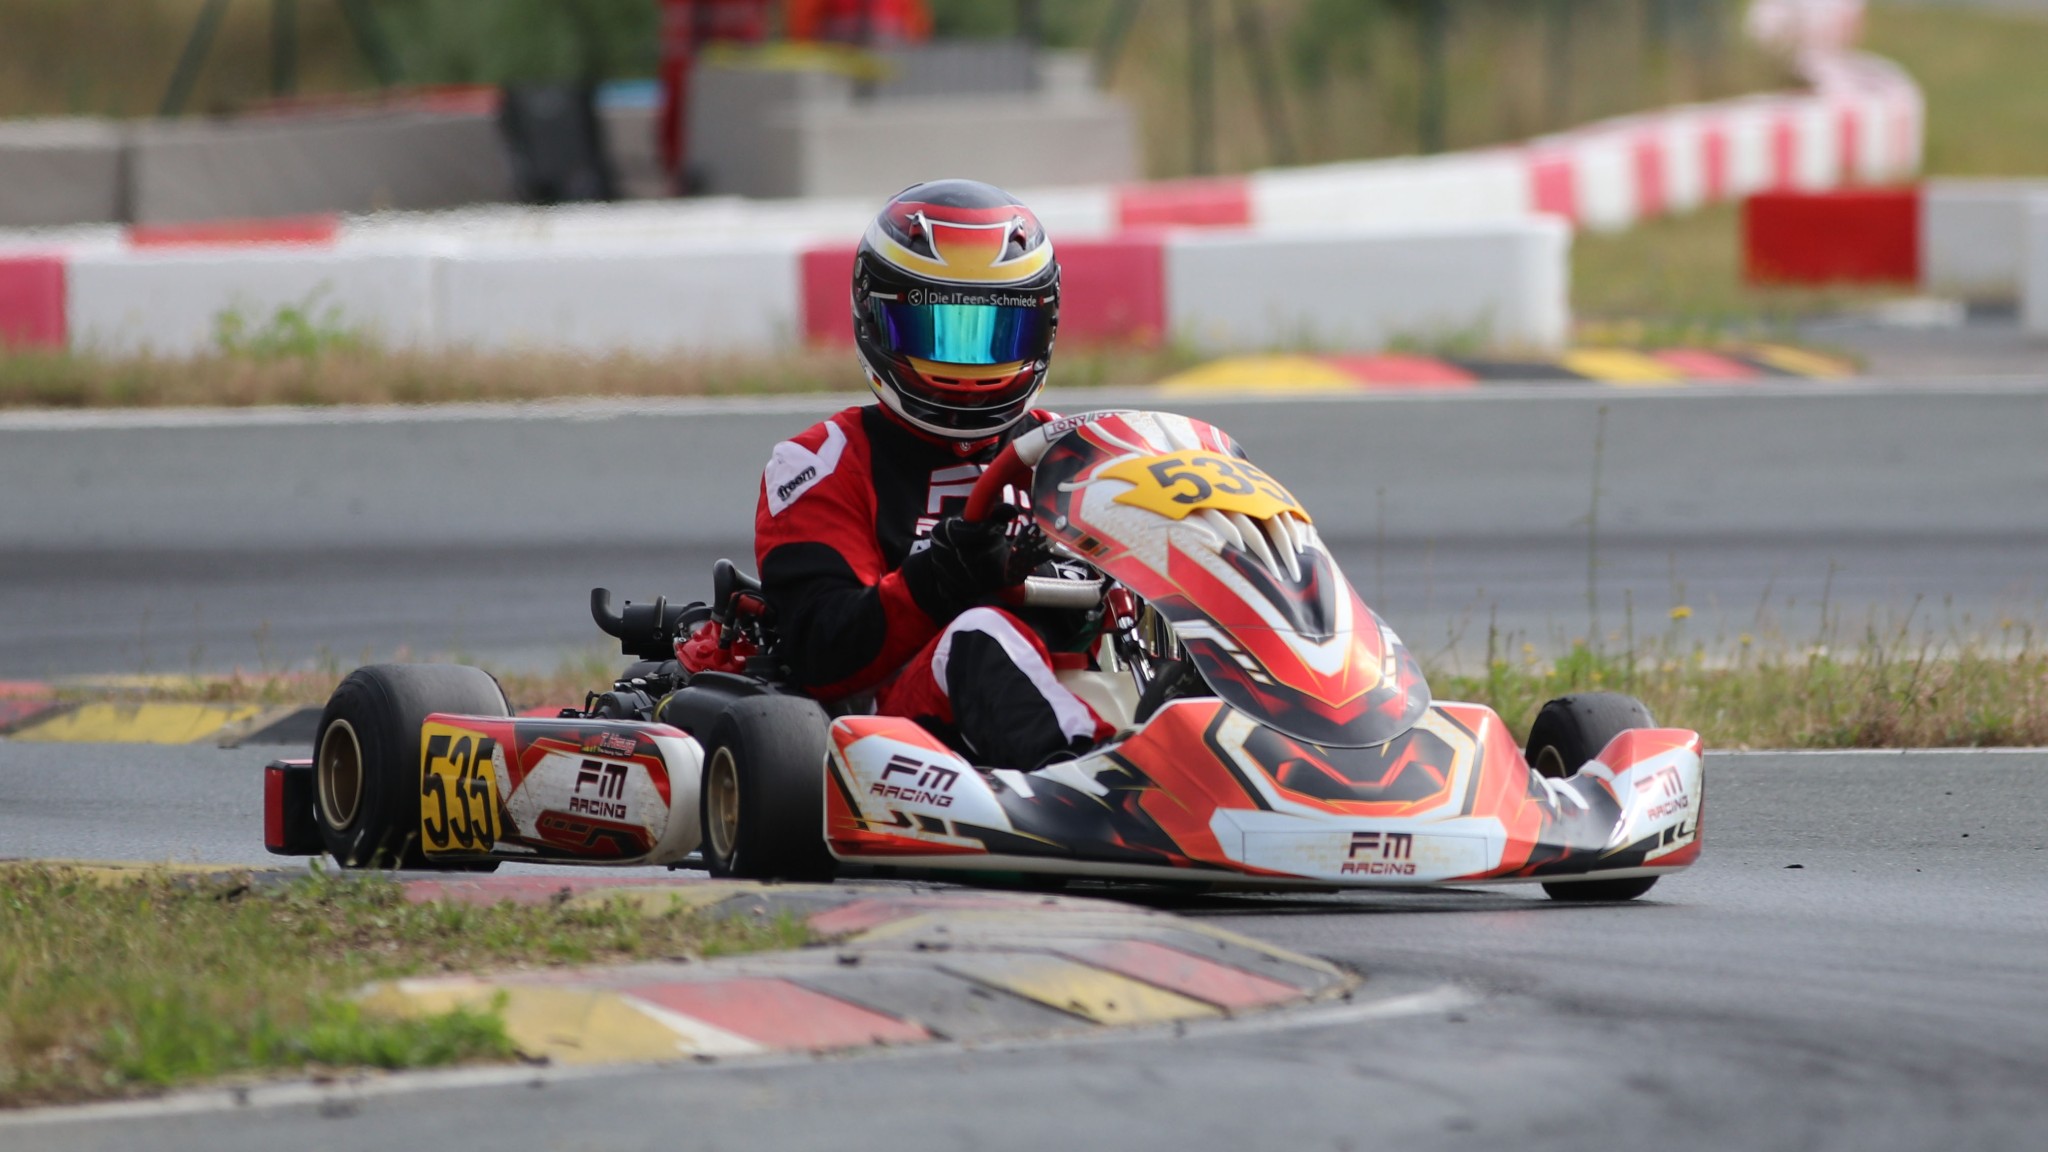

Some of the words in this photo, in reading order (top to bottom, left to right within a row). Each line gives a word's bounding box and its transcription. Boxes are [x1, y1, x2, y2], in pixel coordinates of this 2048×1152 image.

[929, 292, 949, 304] Die
[952, 293, 1037, 307] ITeen-Schmiede
[1147, 457, 1296, 507] 535
[575, 759, 628, 801] FM
[881, 754, 960, 792] FM
[422, 735, 497, 849] 535
[869, 782, 954, 808] RACING
[569, 797, 627, 820] RACING
[1349, 831, 1412, 859] FM
[1340, 863, 1417, 875] RACING
